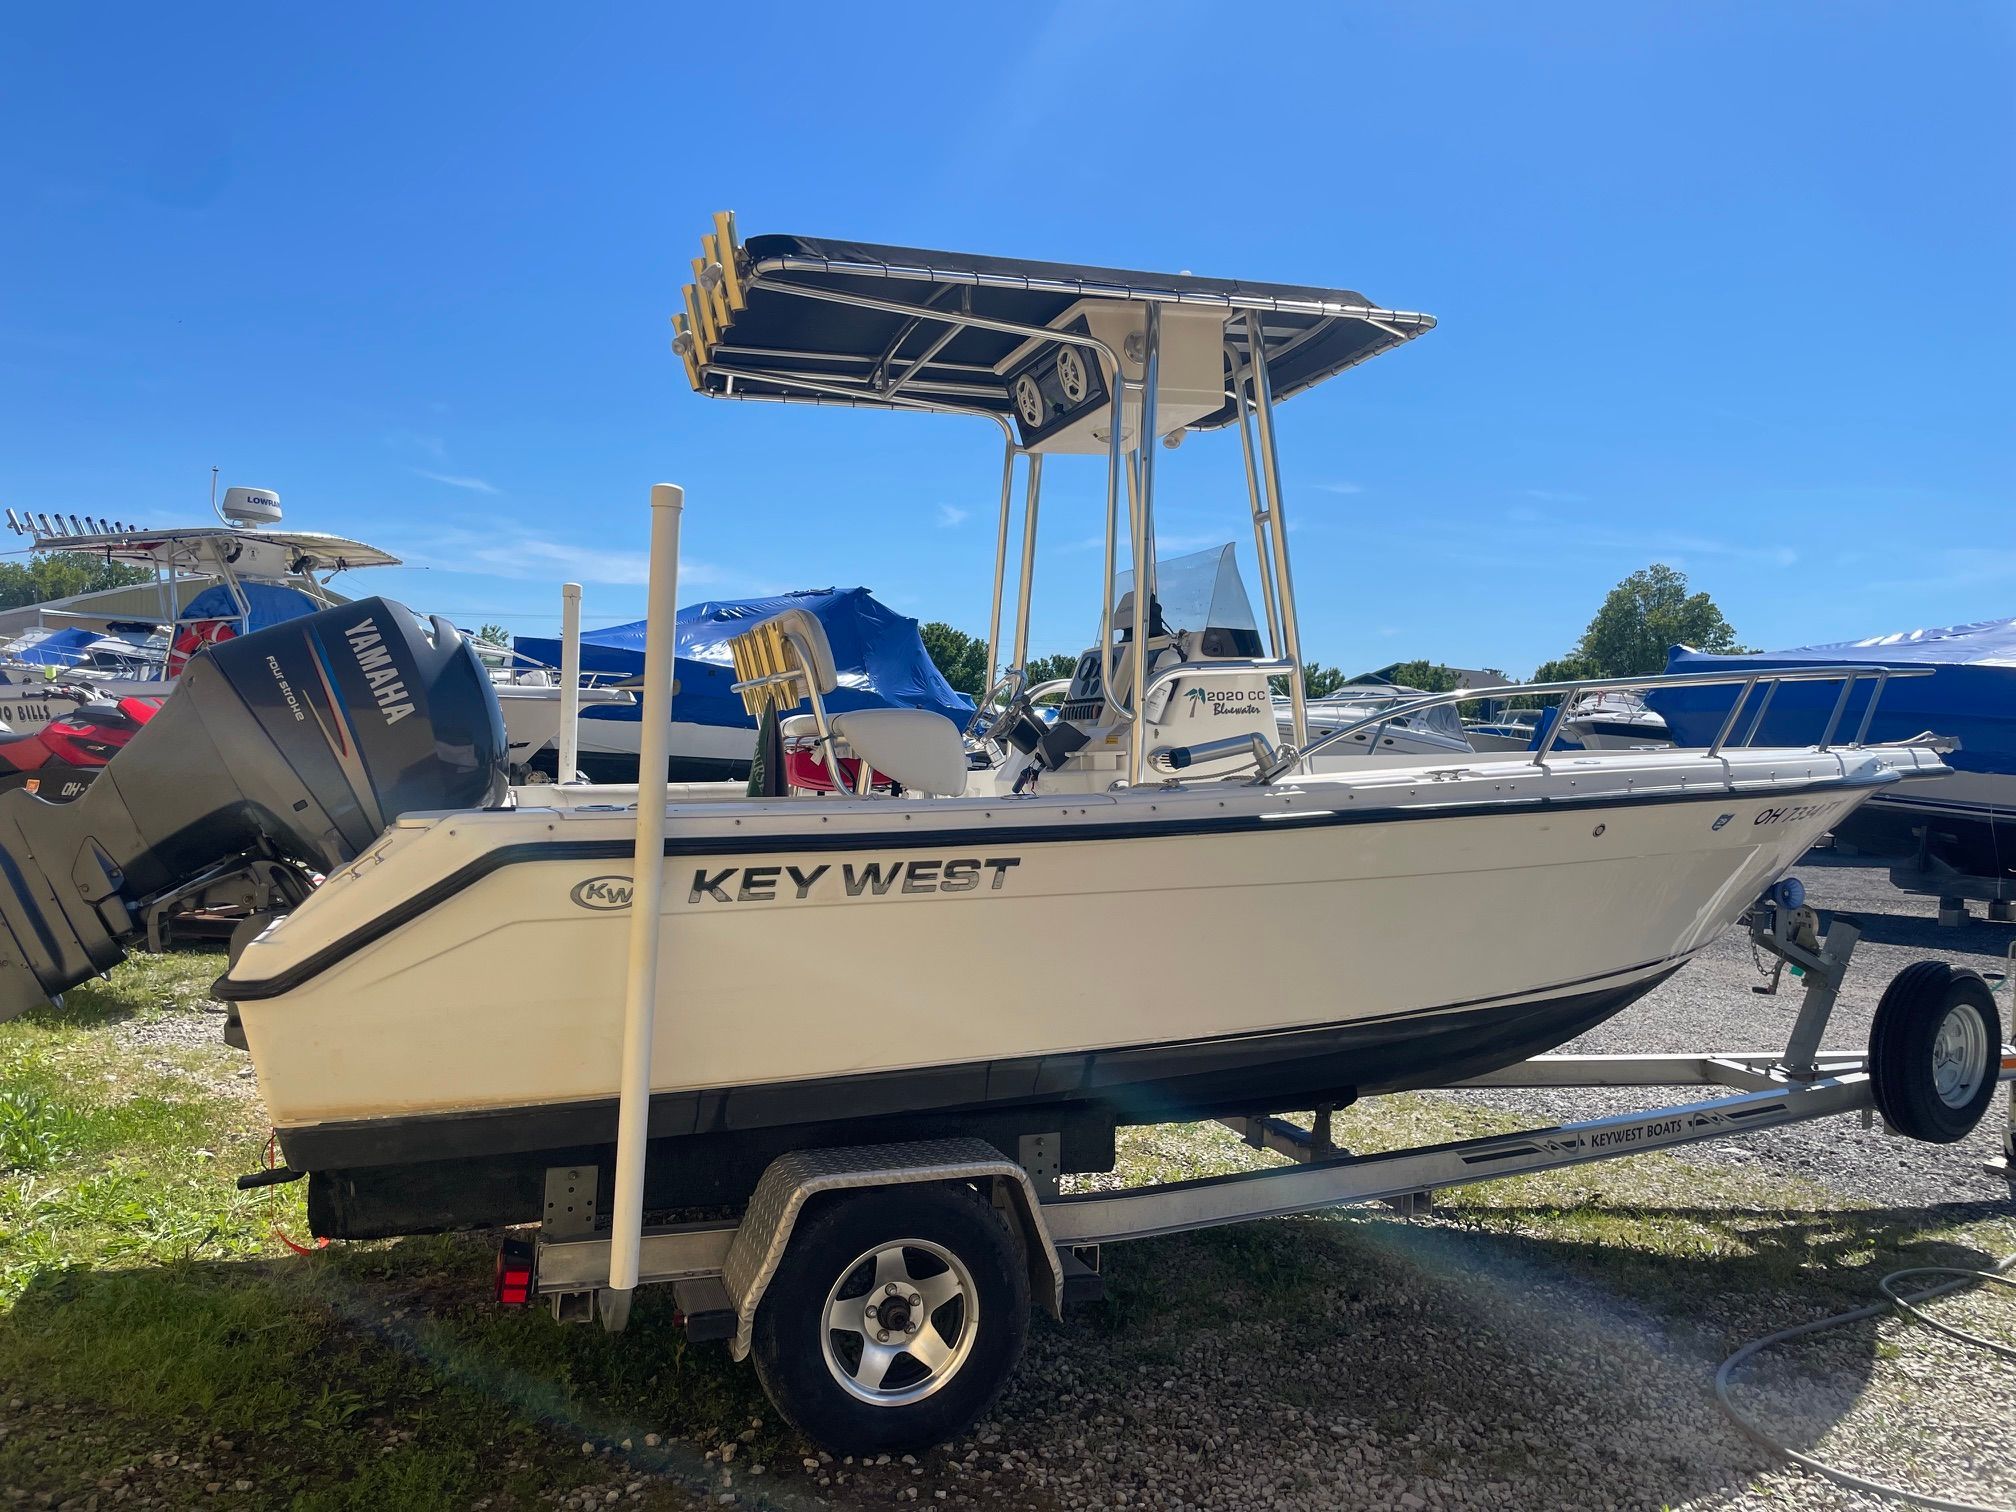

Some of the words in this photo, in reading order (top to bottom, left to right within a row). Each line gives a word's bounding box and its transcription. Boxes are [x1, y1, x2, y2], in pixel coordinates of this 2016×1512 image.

[345, 617, 415, 726] YAMAHA
[1207, 691, 1244, 702] 2020
[1247, 690, 1266, 701] CC
[17, 704, 51, 720] BILLS
[1213, 702, 1261, 716] Bluewater
[1754, 808, 1788, 825] OH
[688, 865, 832, 904] KEY
[842, 857, 1021, 897] WEST
[1591, 1127, 1643, 1148] KEYWEST
[1647, 1120, 1682, 1138] BOATS
